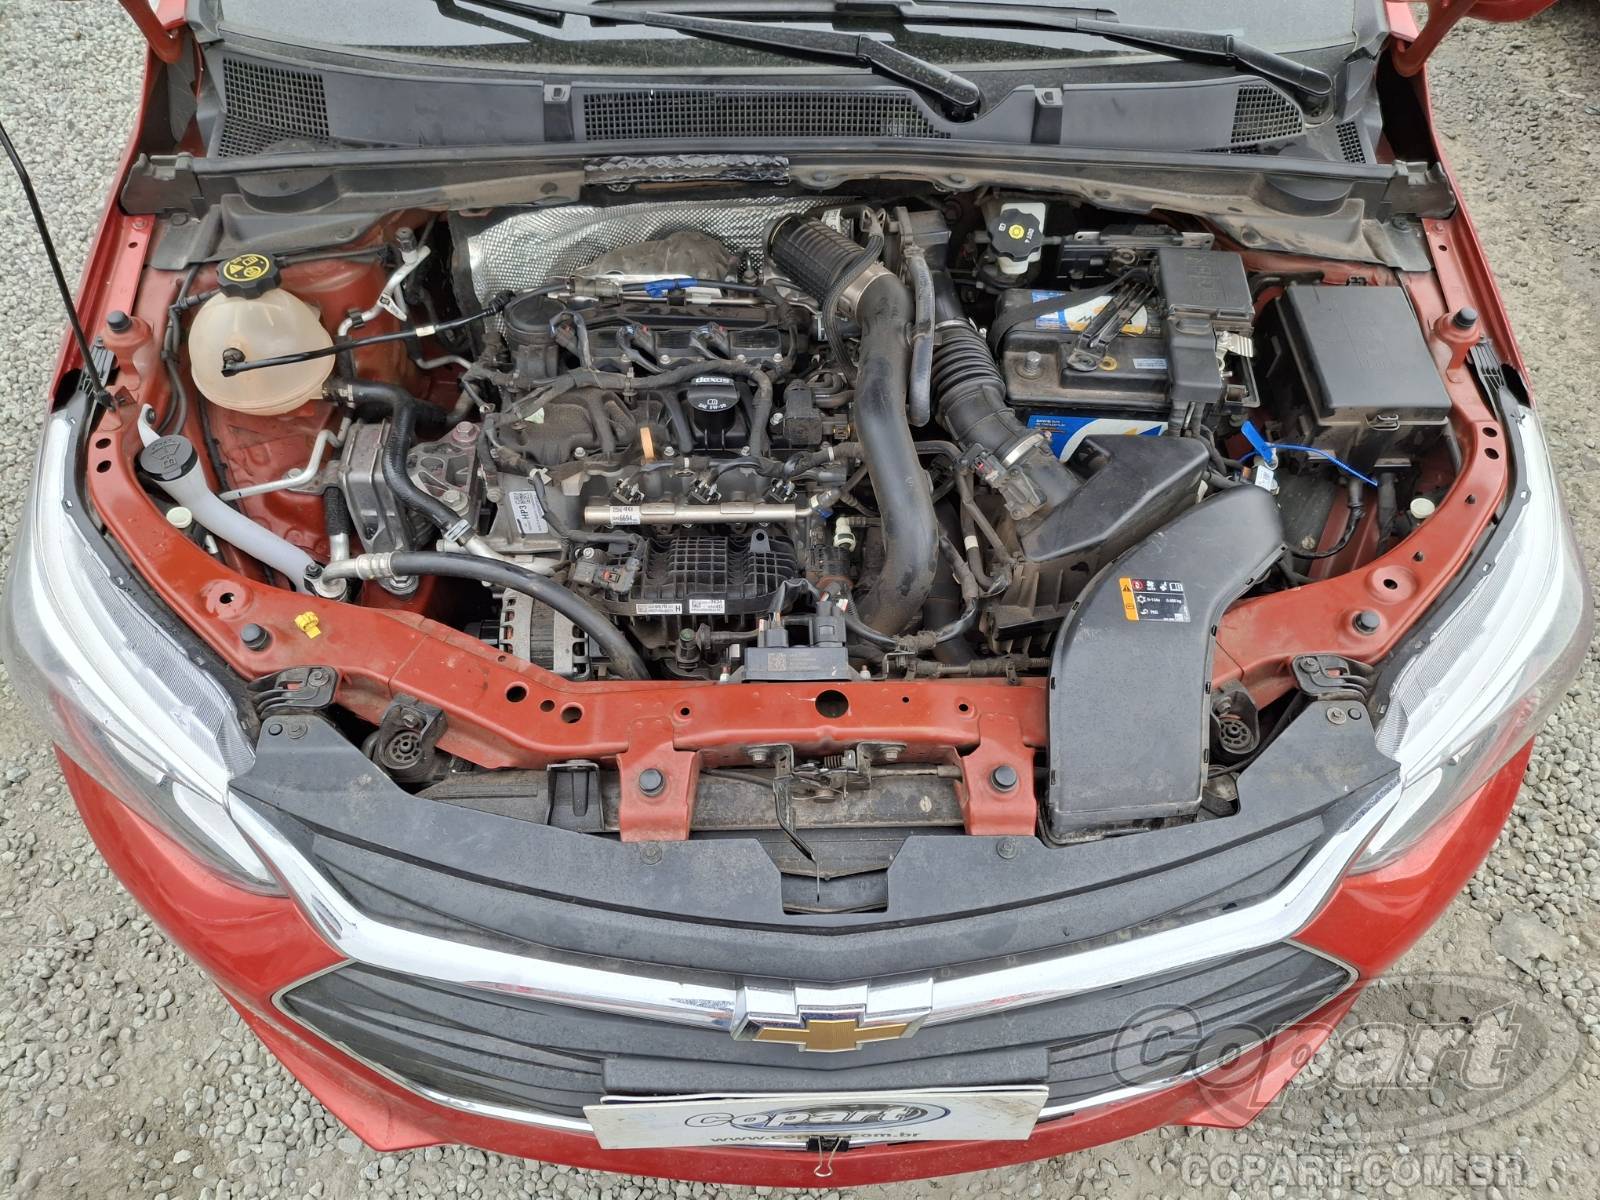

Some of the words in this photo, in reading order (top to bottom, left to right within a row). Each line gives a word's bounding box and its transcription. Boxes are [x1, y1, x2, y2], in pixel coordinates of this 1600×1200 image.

[519, 504, 530, 520] HP3
[684, 1103, 916, 1128] Copart
[711, 1131, 921, 1142] www.cop.com.br
